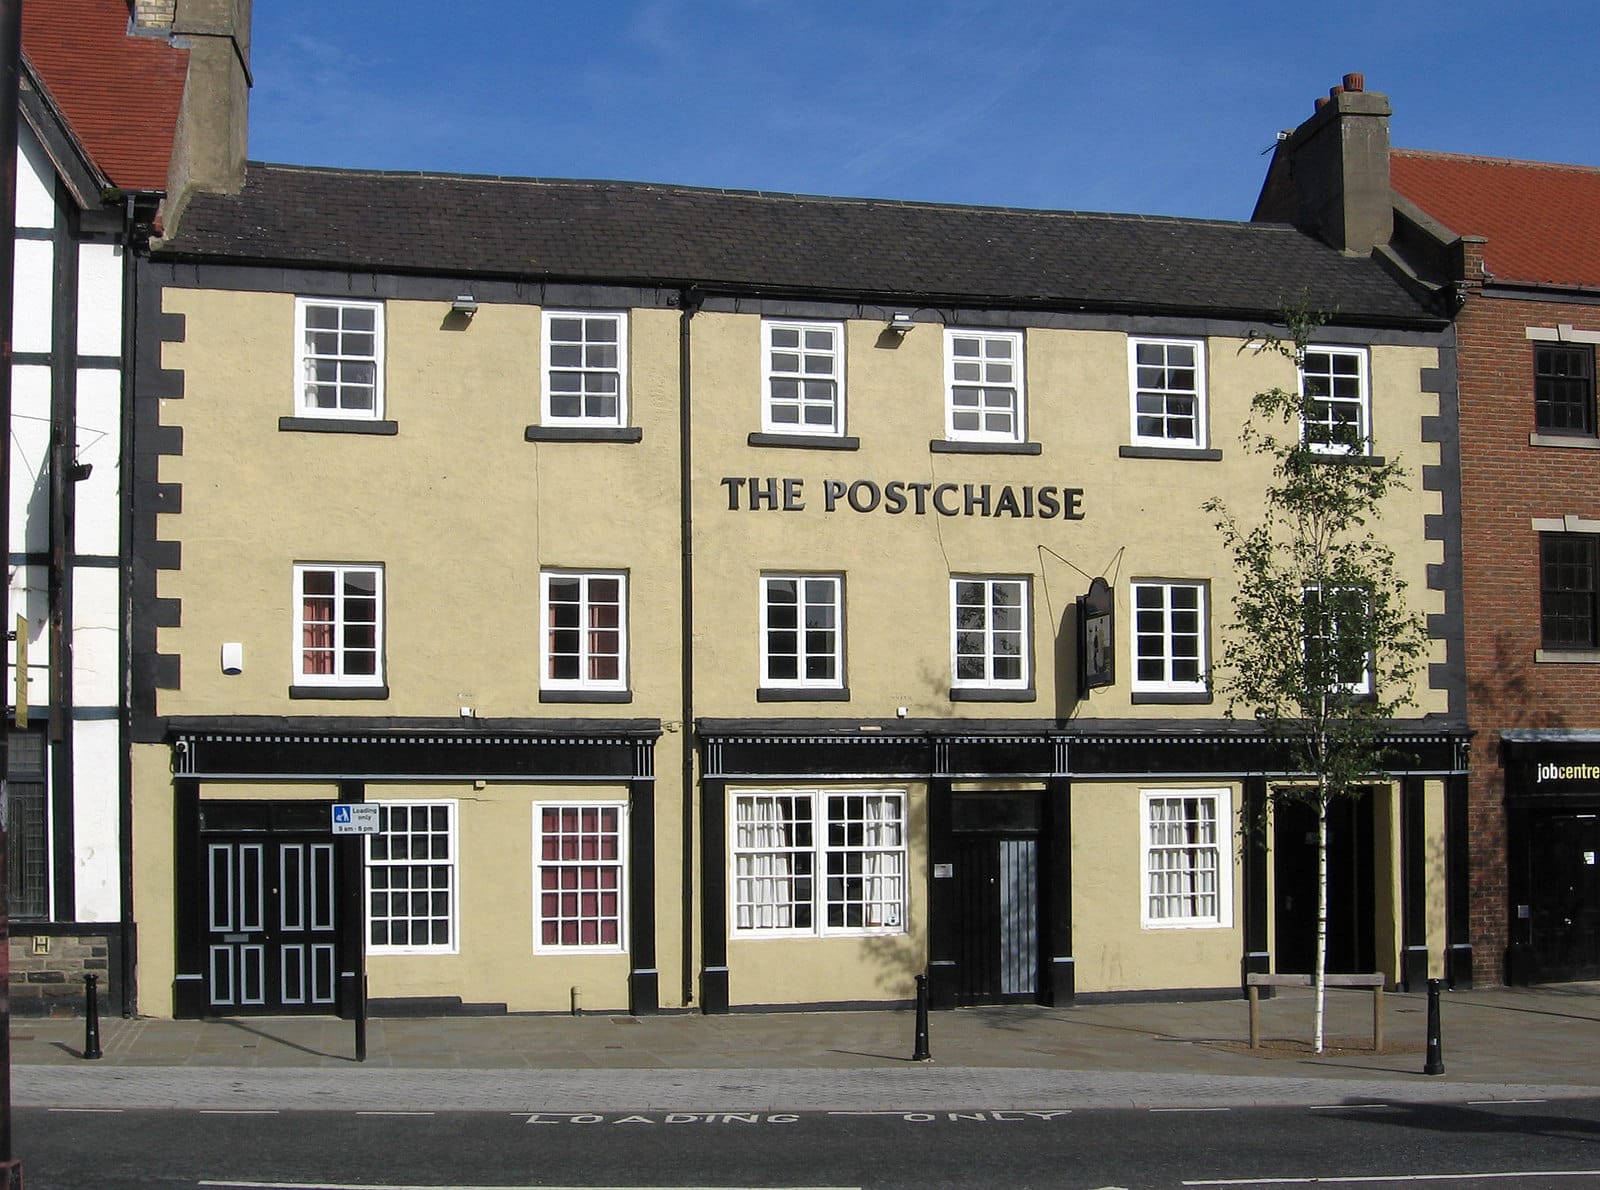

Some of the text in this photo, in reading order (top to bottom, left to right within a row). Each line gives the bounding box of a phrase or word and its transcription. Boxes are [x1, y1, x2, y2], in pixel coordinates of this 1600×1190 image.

[721, 477, 1086, 521] THE POSTCHAISE
[1536, 762, 1600, 784] jobcentre
[34, 936, 49, 953] H
[525, 1110, 1073, 1124] LOADING ONLY
